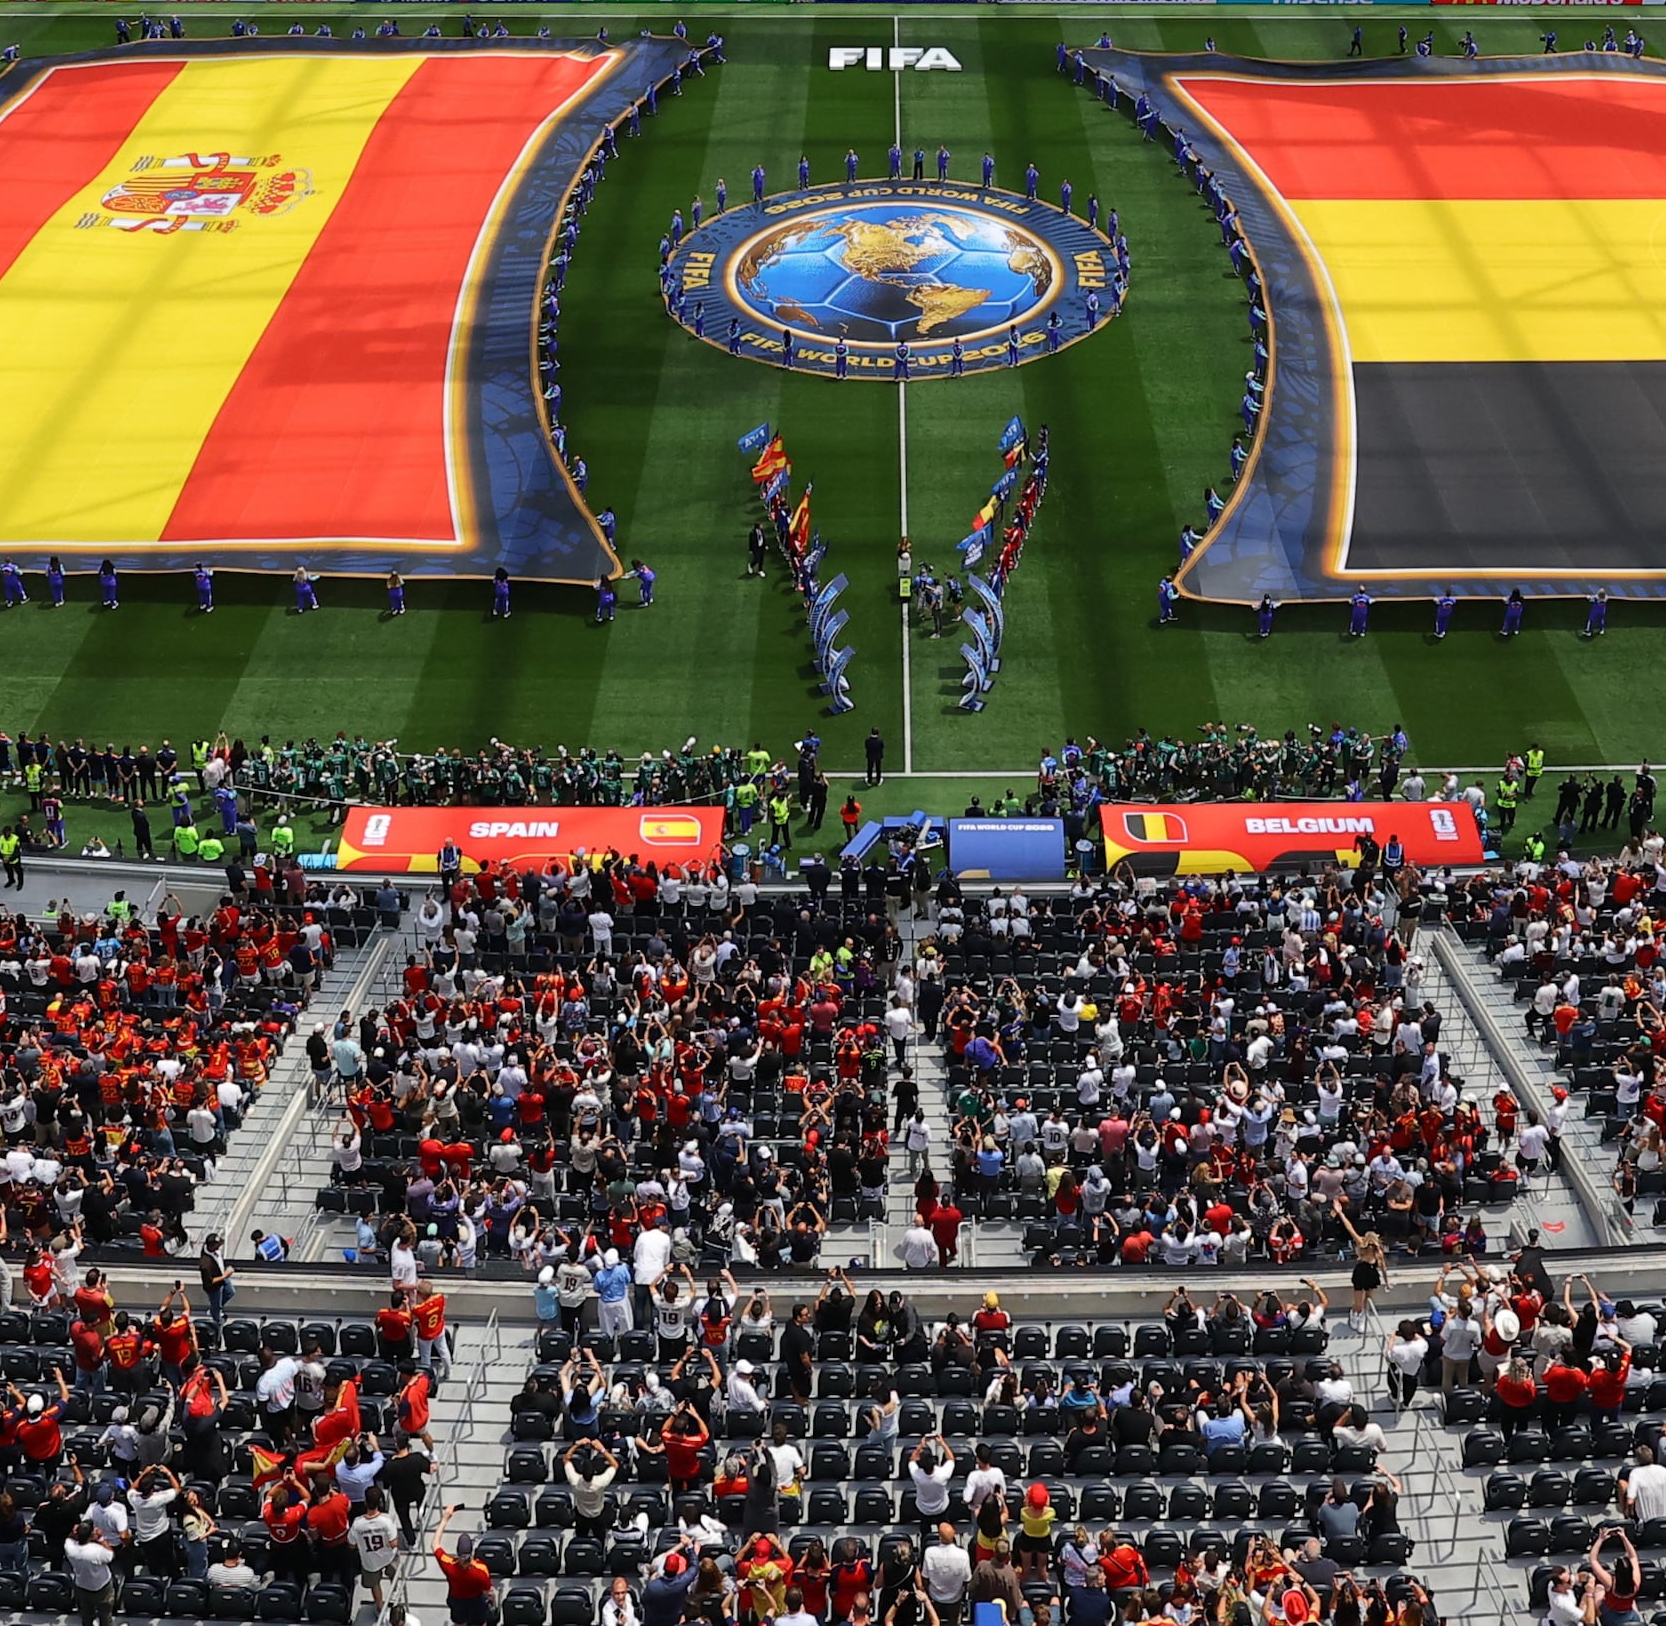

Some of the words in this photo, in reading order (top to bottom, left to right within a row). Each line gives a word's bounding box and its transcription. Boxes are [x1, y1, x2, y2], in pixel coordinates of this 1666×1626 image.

[828, 47, 963, 72] FIFA
[847, 186, 893, 199] CUP
[896, 185, 979, 203] WORLD
[764, 190, 847, 215] 2026
[981, 196, 1031, 215] FIFA
[682, 252, 717, 292] FIFA
[1072, 249, 1106, 288] FIFA
[468, 821, 559, 838] SPAIN
[957, 824, 976, 832] FIFA
[977, 824, 1007, 832] WORLD
[1007, 824, 1025, 832] CUP
[1245, 816, 1376, 834] BELGIUM
[1049, 1131, 1061, 1143] 10
[564, 1276, 578, 1292] 19
[427, 1313, 439, 1329] 8
[363, 1534, 384, 1553] 19
